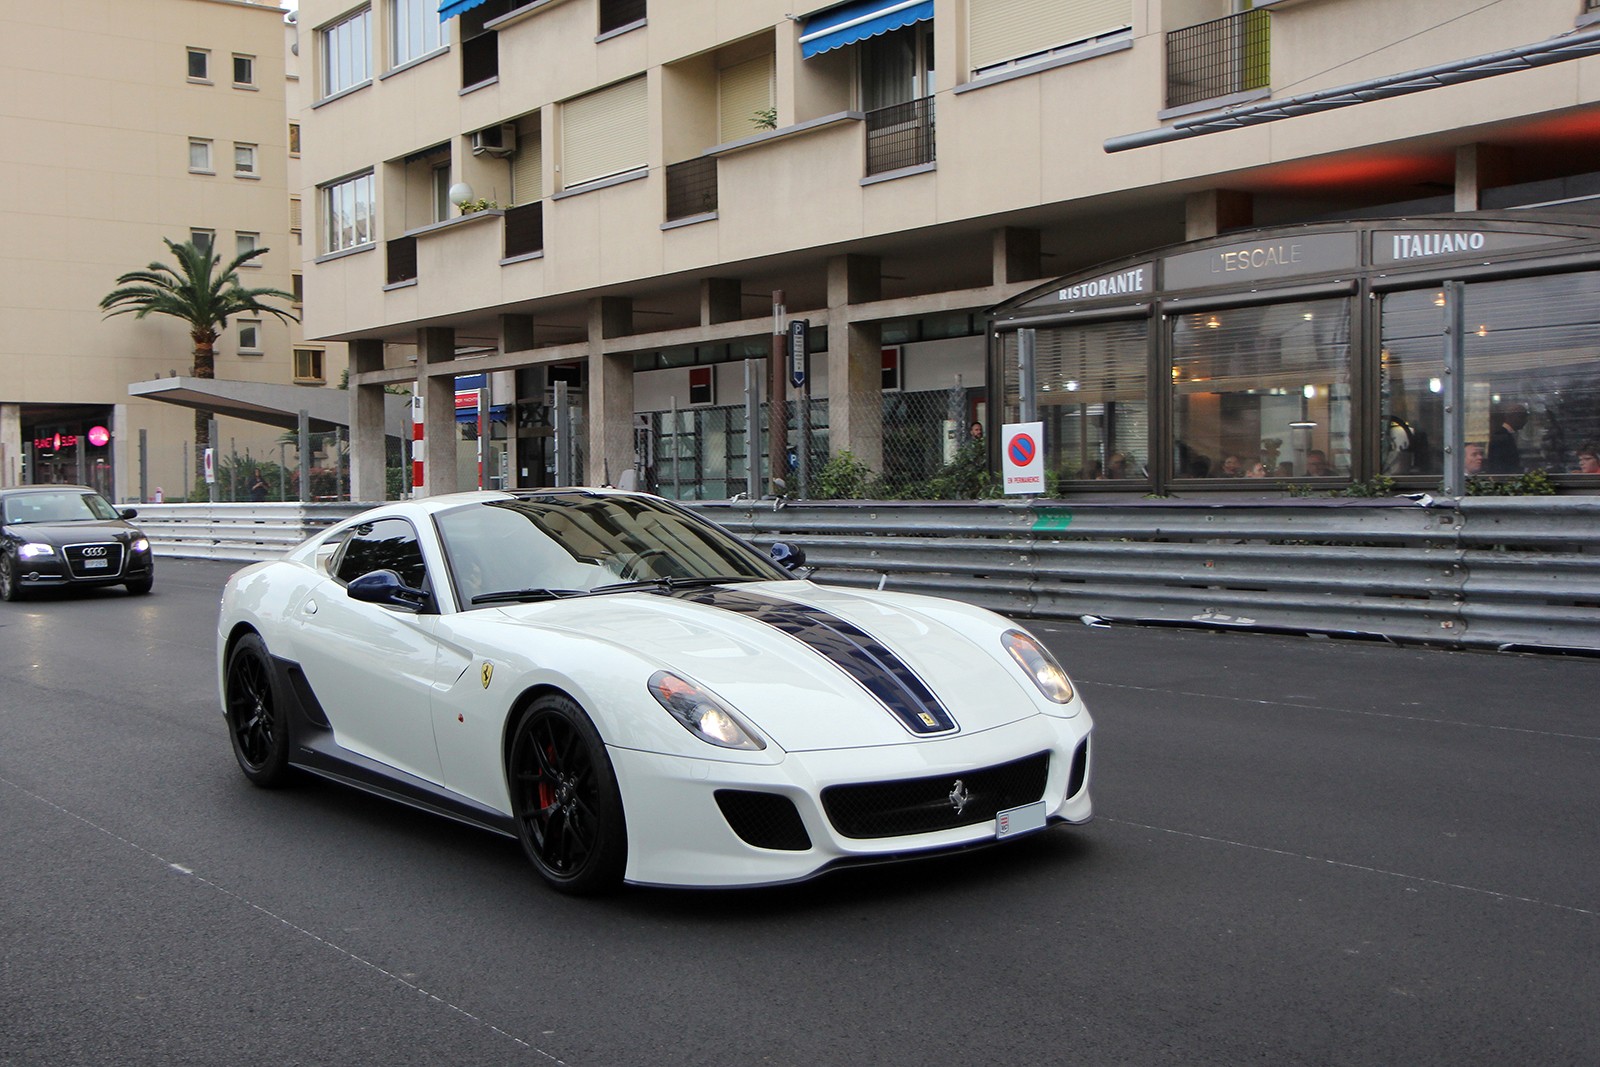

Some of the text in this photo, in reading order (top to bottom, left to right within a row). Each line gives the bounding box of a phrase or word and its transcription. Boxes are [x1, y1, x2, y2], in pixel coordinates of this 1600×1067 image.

[1211, 244, 1302, 273] L'ESCALE
[1393, 233, 1485, 259] ITALIANO
[1058, 268, 1144, 301] RISTORANTE
[1014, 476, 1040, 484] PERMANENCE
